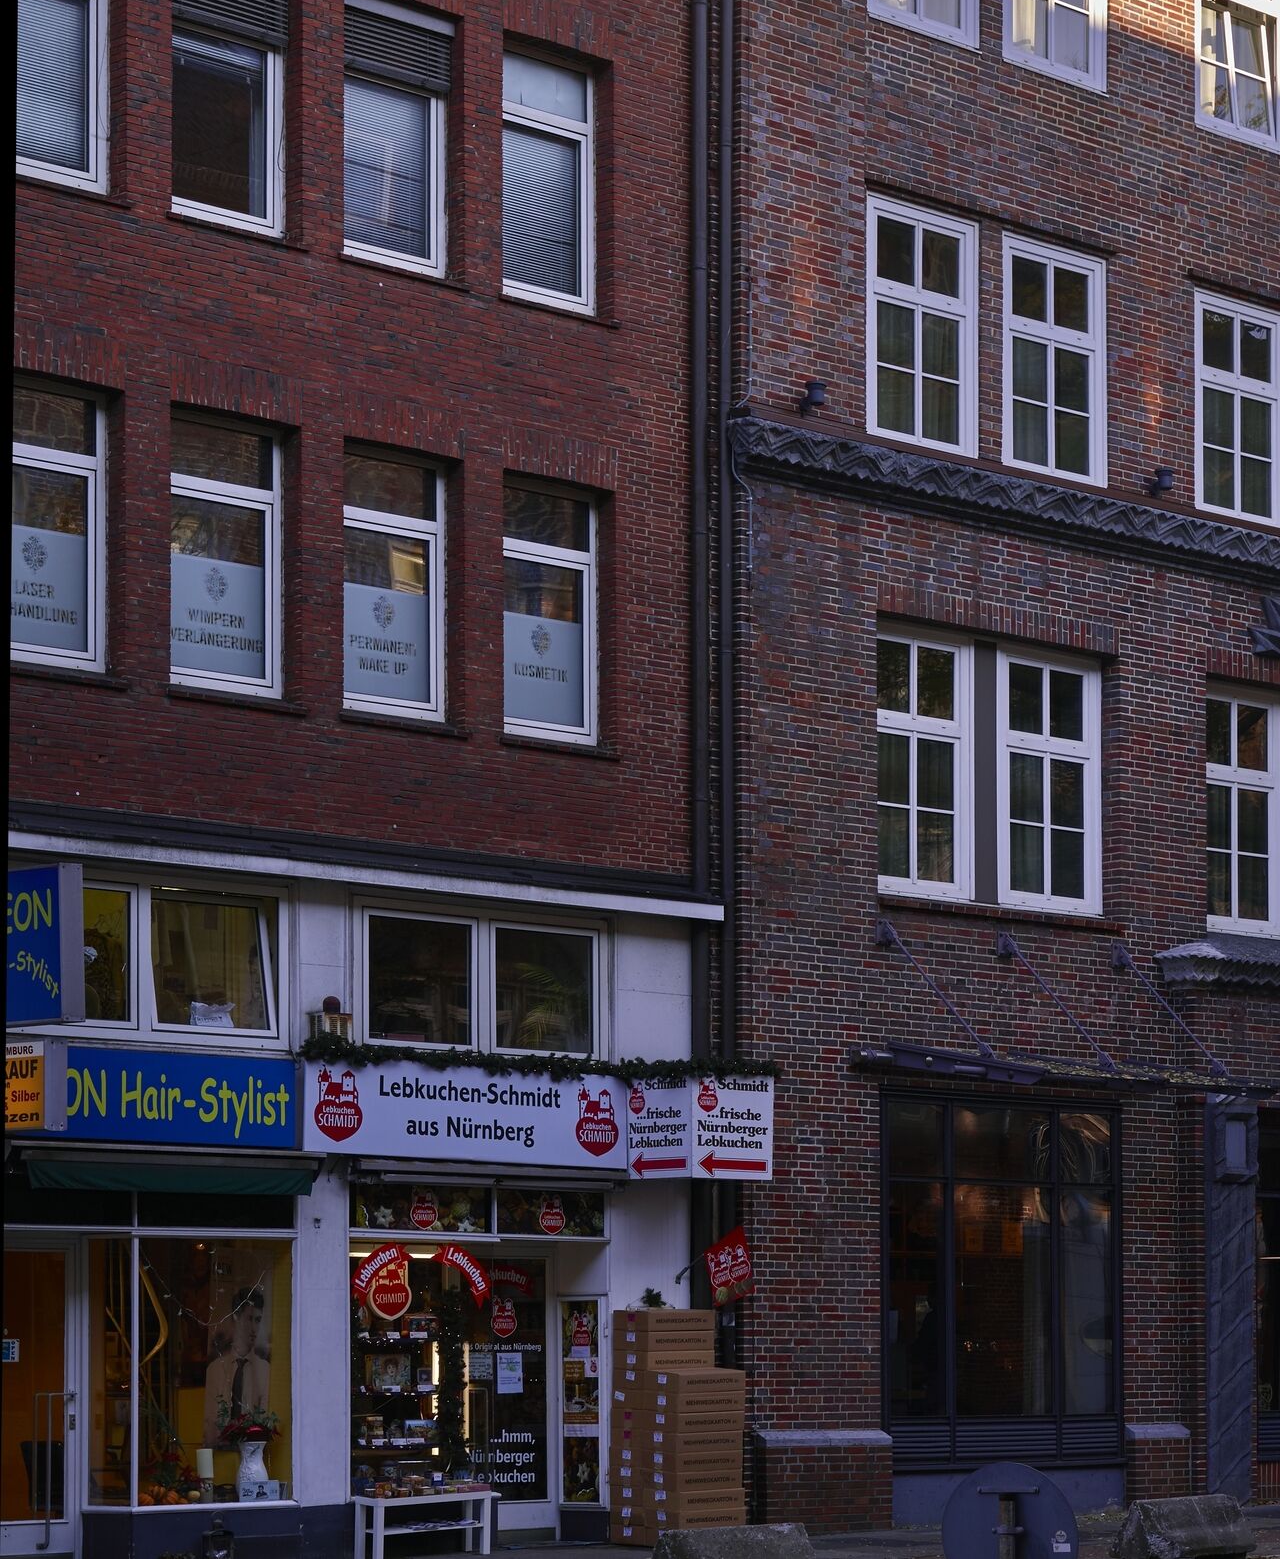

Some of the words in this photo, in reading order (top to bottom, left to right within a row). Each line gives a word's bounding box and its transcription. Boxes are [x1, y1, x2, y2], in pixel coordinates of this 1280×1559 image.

[15, 580, 55, 599] LASER
[188, 608, 245, 629] WIMPERN
[358, 656, 389, 673] MAKE
[394, 661, 408, 675] UP
[514, 662, 568, 683] KOSMETIK
[379, 1075, 561, 1109] Lebkuchen-Schmidt
[717, 1078, 769, 1092] Schmidt
[11, 1090, 40, 1103] Silber
[121, 1069, 290, 1139] Hair-Stylist
[322, 1105, 355, 1115] Lebkuchen
[318, 1113, 359, 1129] SCHMIDT
[582, 1122, 612, 1131] Lebkuchen
[697, 1120, 768, 1137] Nürnberger
[406, 1118, 439, 1137] aus
[446, 1116, 535, 1147] Nürnberg
[579, 1129, 615, 1144] SCHMIDT
[629, 1122, 687, 1137] Nürnberger
[629, 1135, 683, 1149] Lebkuchen
[697, 1134, 763, 1149] Lebkuchen
[413, 1212, 436, 1221] SCHMIDT
[355, 1247, 398, 1288] Lebkuchen
[447, 1247, 486, 1290] Lebkuchen
[375, 1292, 407, 1304] SCHMIDT
[513, 1343, 542, 1352] Nürnberg
